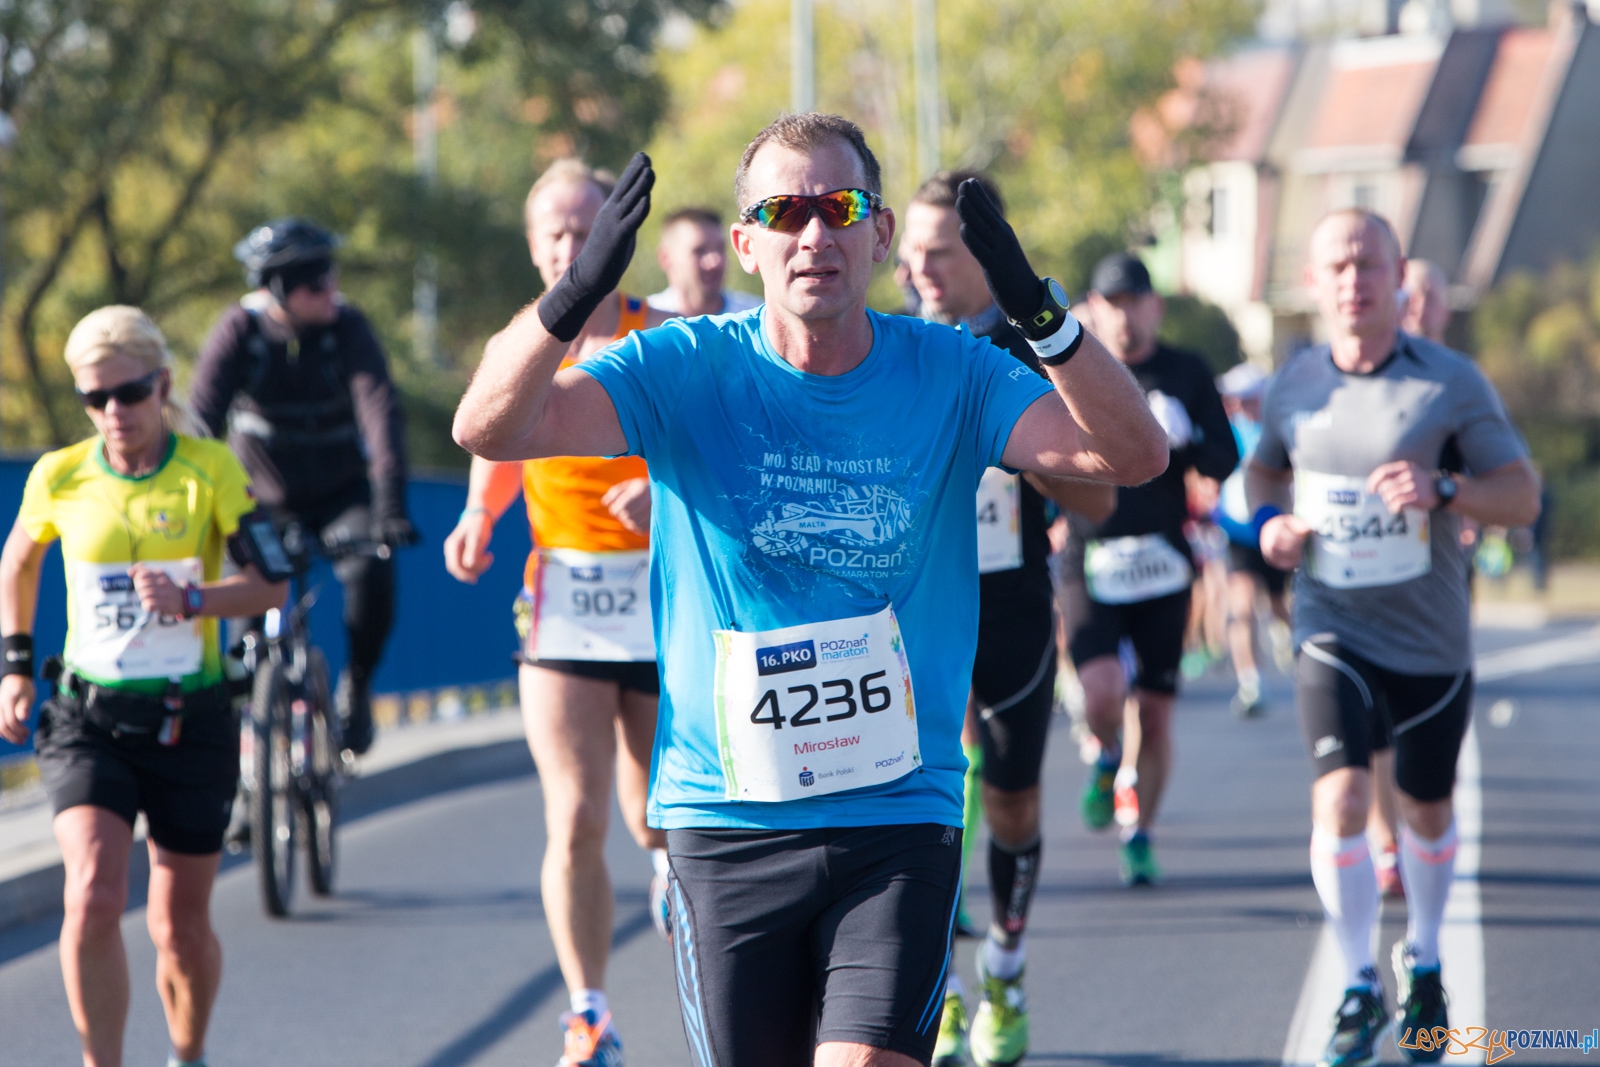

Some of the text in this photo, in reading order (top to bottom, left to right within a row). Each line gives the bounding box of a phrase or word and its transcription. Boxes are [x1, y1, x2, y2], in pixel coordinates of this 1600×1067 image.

[826, 457, 891, 474] POZOSTAŁ
[760, 472, 837, 495] W POZNANIU
[798, 521, 826, 529] MALTA
[572, 588, 637, 617] 902
[761, 654, 780, 668] 16.
[782, 648, 811, 664] PKO
[821, 646, 869, 660] maraton
[750, 669, 891, 730] 4236
[793, 735, 860, 755] Mirosław
[818, 766, 855, 780] Bank Polski
